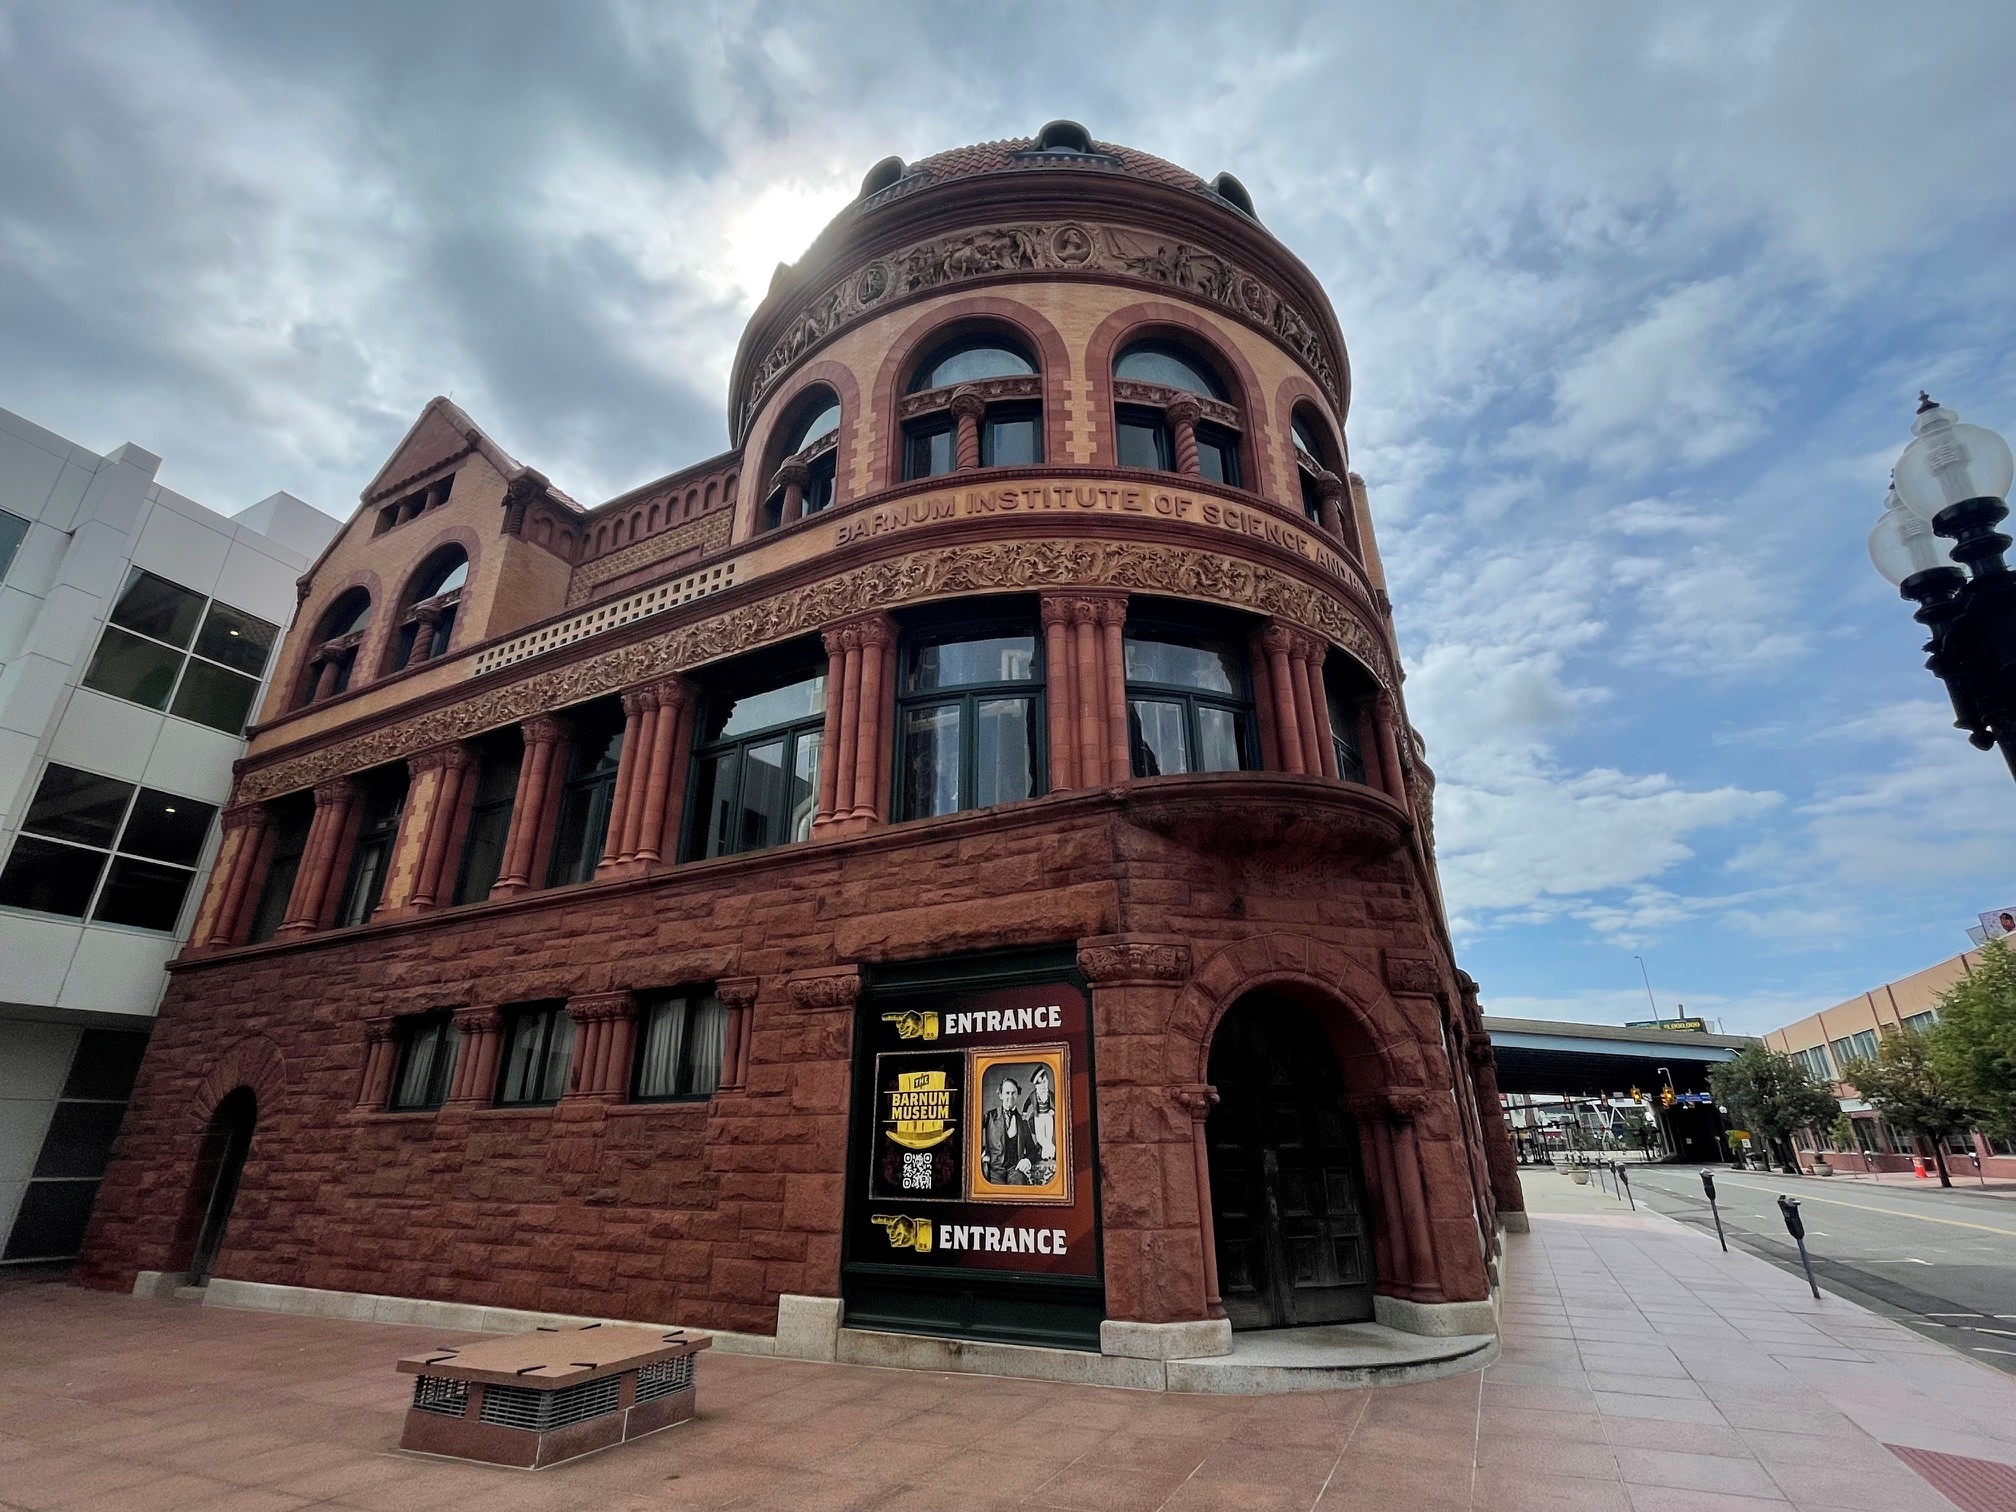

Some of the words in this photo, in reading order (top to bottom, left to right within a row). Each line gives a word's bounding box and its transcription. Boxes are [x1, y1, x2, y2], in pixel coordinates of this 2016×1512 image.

[836, 496, 955, 546] BARNUM
[966, 487, 1142, 514] INSTITUTE
[1154, 494, 1192, 517] OF
[1202, 503, 1310, 559] SCIENCE
[1316, 547, 1346, 579] AND
[945, 1005, 1062, 1035] ENTRANCE
[914, 1076, 929, 1087] THE
[892, 1091, 949, 1107] BARNUM
[891, 1105, 949, 1120] MUSEUM
[940, 1224, 1067, 1255] ENTRANCE
